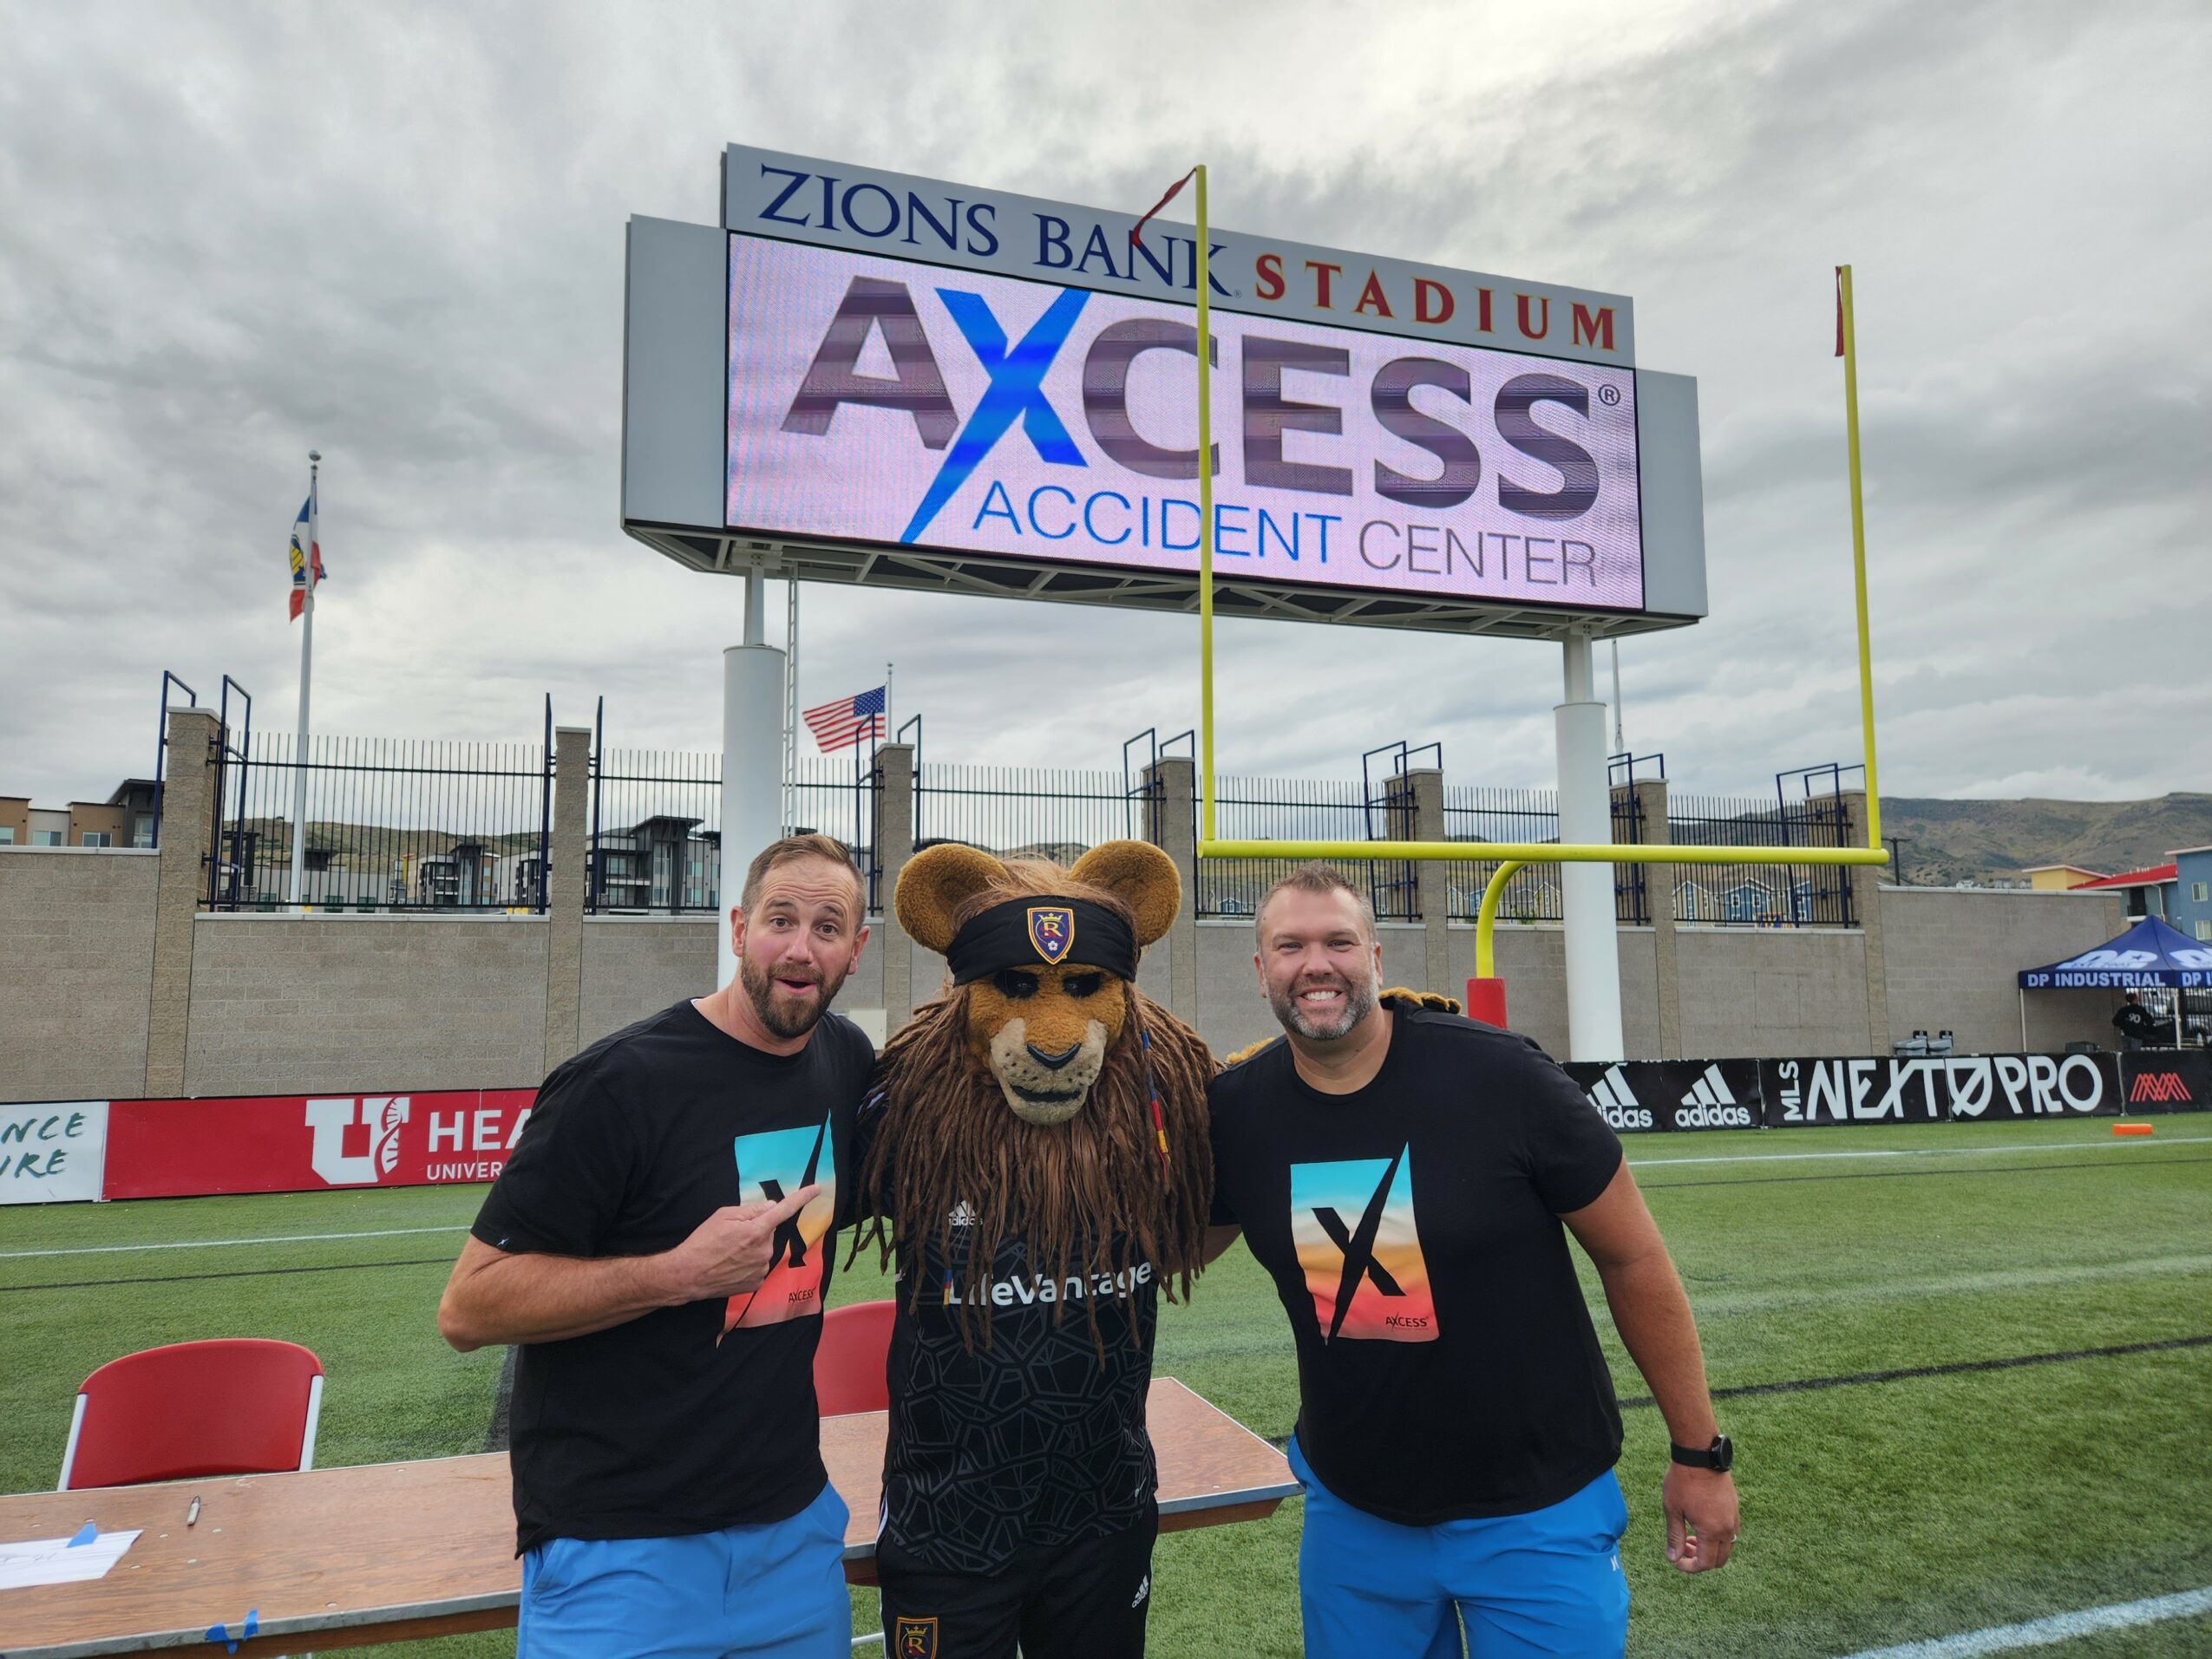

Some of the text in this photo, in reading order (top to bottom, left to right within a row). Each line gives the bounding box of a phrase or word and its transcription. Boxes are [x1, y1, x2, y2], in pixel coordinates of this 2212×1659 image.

[757, 162, 999, 258] ZIONS
[1254, 253, 1617, 350] STADIUM
[972, 480, 1598, 587] ACCIDENT CENTER
[2027, 972, 2166, 987] DP INDUSTRIAL
[2182, 972, 2202, 987] DP
[2129, 1013, 2141, 1023] 90
[1778, 1061, 1803, 1120] MLS
[1675, 1102, 1751, 1127] adidas
[948, 1216, 984, 1226] dida
[1385, 1311, 1428, 1331] AXCESS
